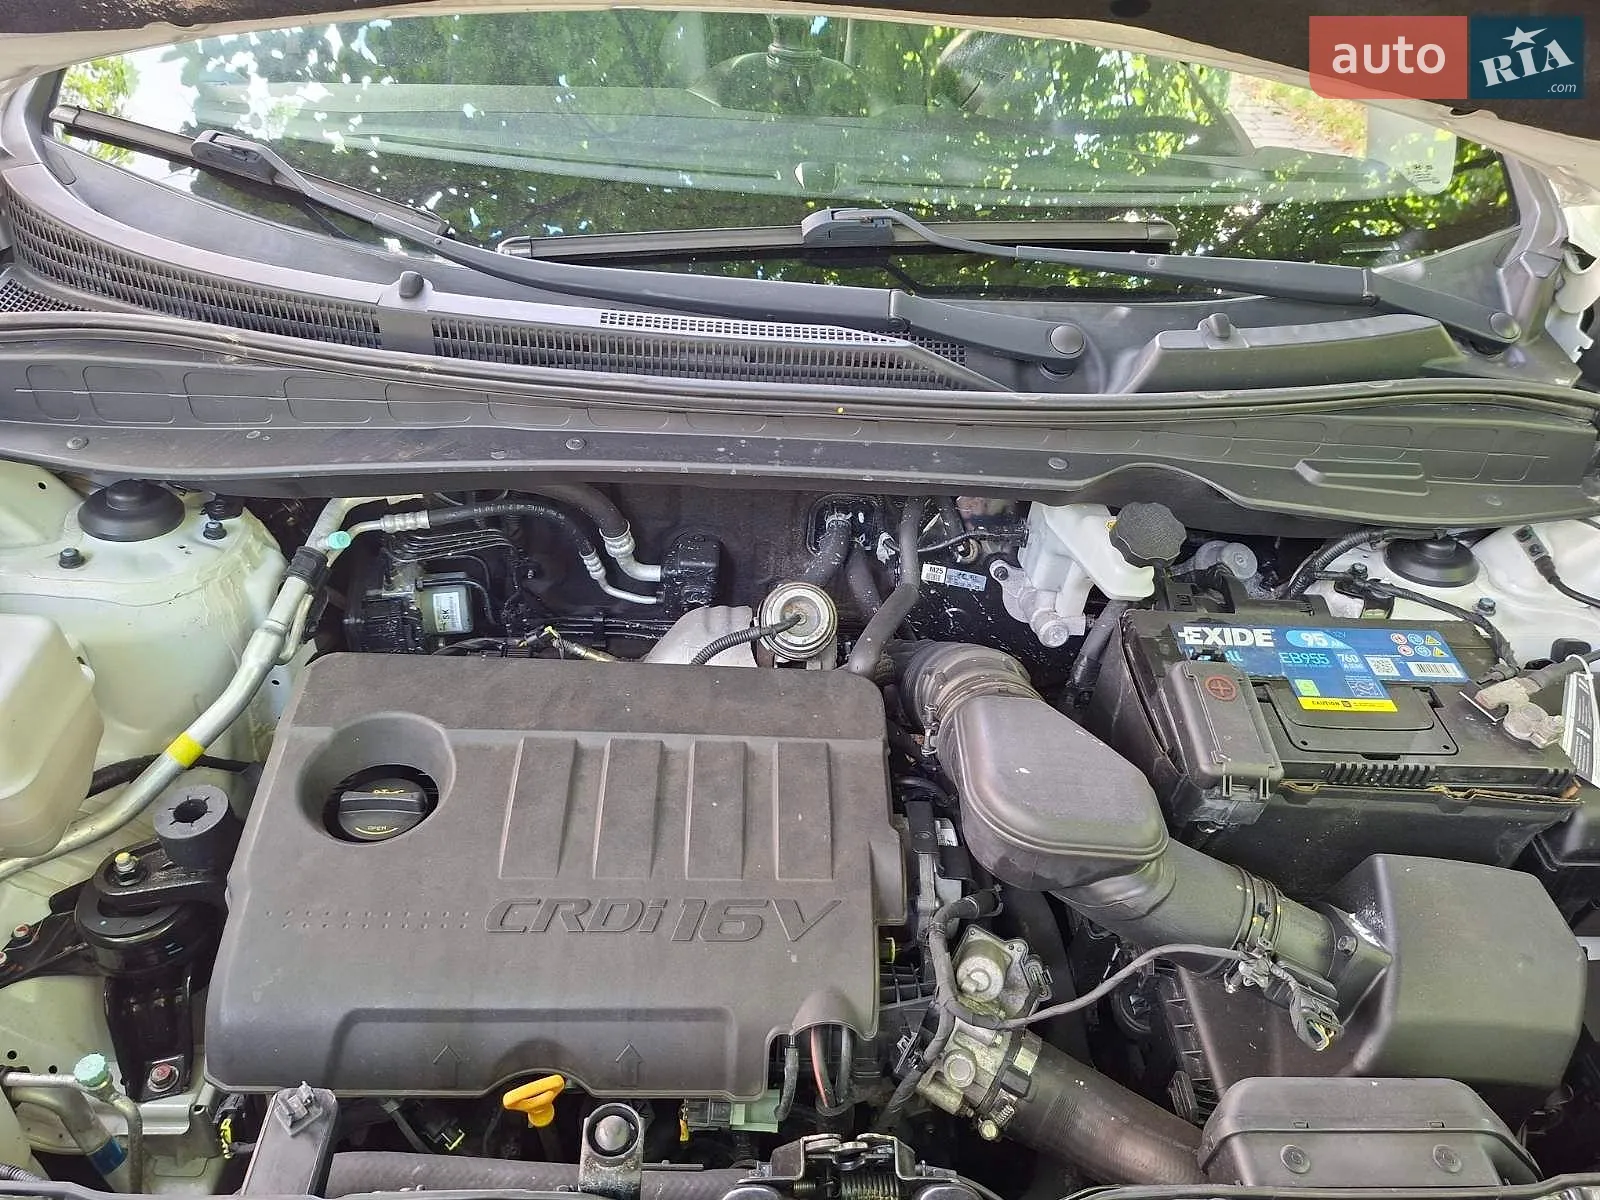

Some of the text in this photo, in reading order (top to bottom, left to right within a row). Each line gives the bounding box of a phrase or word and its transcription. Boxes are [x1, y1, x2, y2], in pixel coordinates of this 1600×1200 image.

[1178, 626, 1275, 647] EXIDE
[1300, 631, 1329, 648] 95
[1279, 652, 1330, 665] EB955
[1336, 653, 1359, 663] 760
